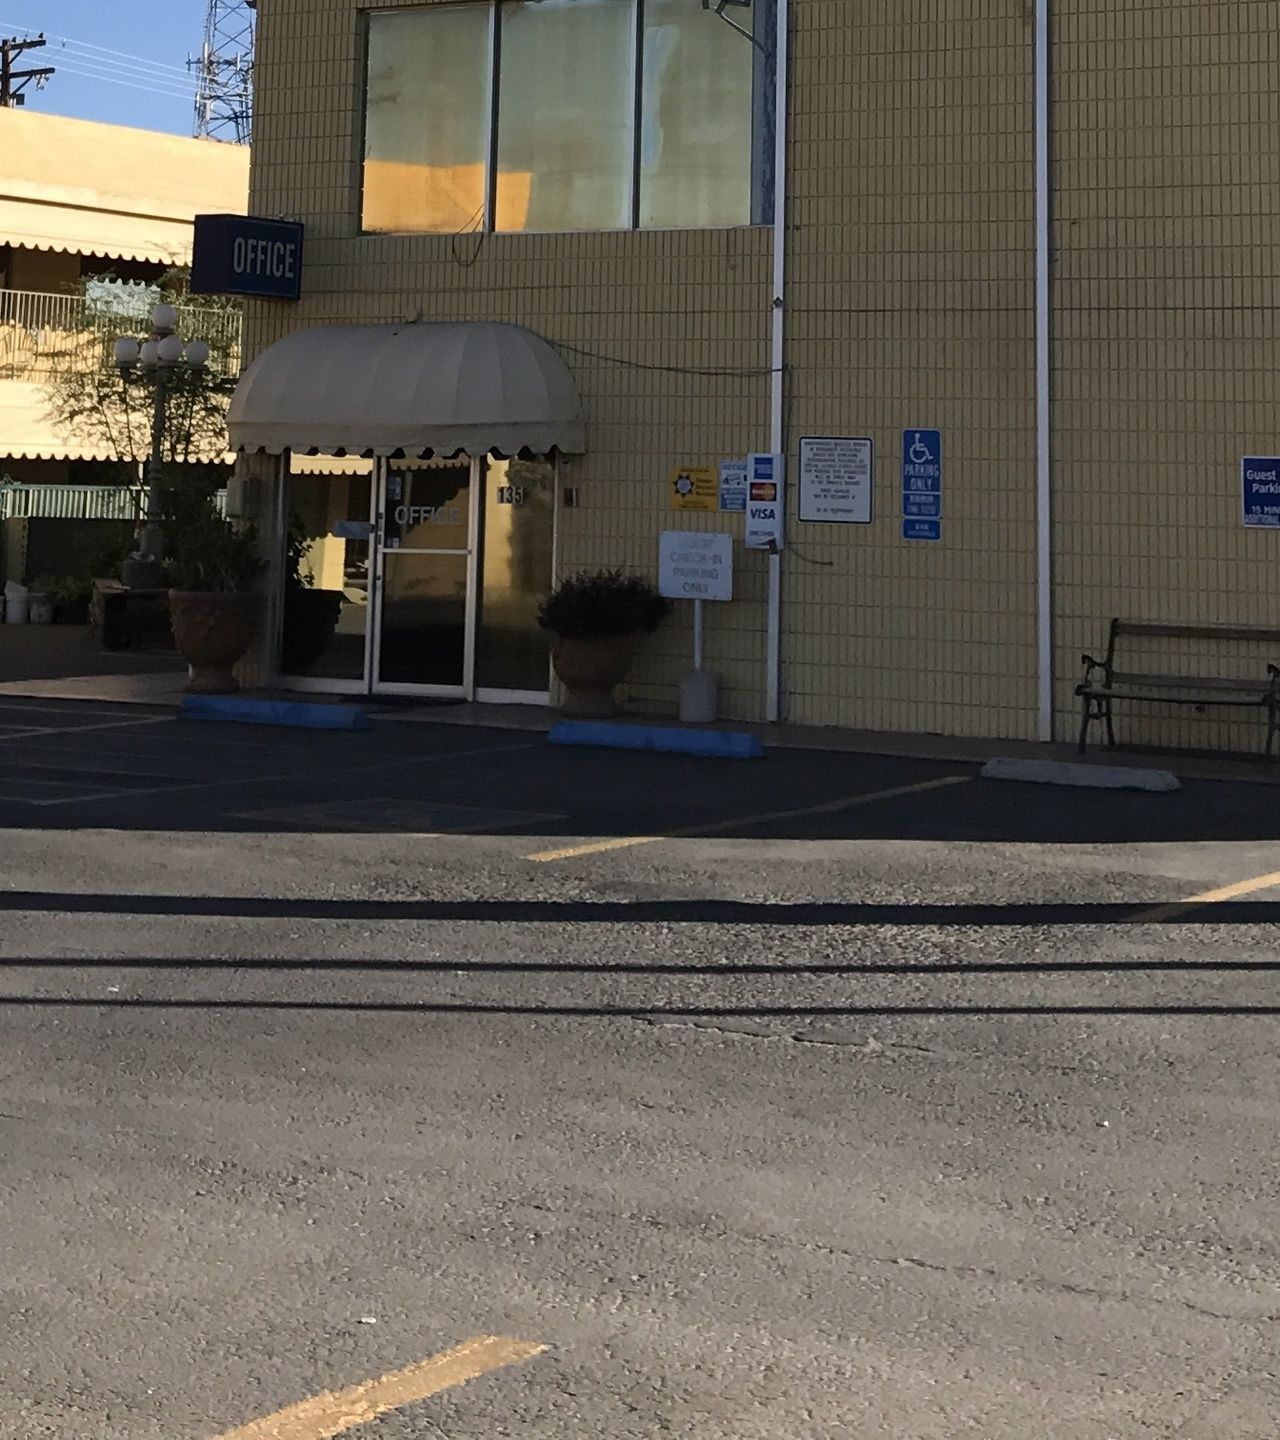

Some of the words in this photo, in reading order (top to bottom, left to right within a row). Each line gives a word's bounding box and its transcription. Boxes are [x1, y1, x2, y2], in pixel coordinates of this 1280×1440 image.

[232, 236, 295, 278] OFFICE
[904, 464, 939, 477] PARKING
[1246, 470, 1277, 480] Guest
[910, 478, 933, 490] ONLY
[394, 506, 461, 525] OFFICE
[750, 508, 776, 520] VISA
[673, 567, 719, 579] PARKING
[682, 582, 709, 593] ONLY
